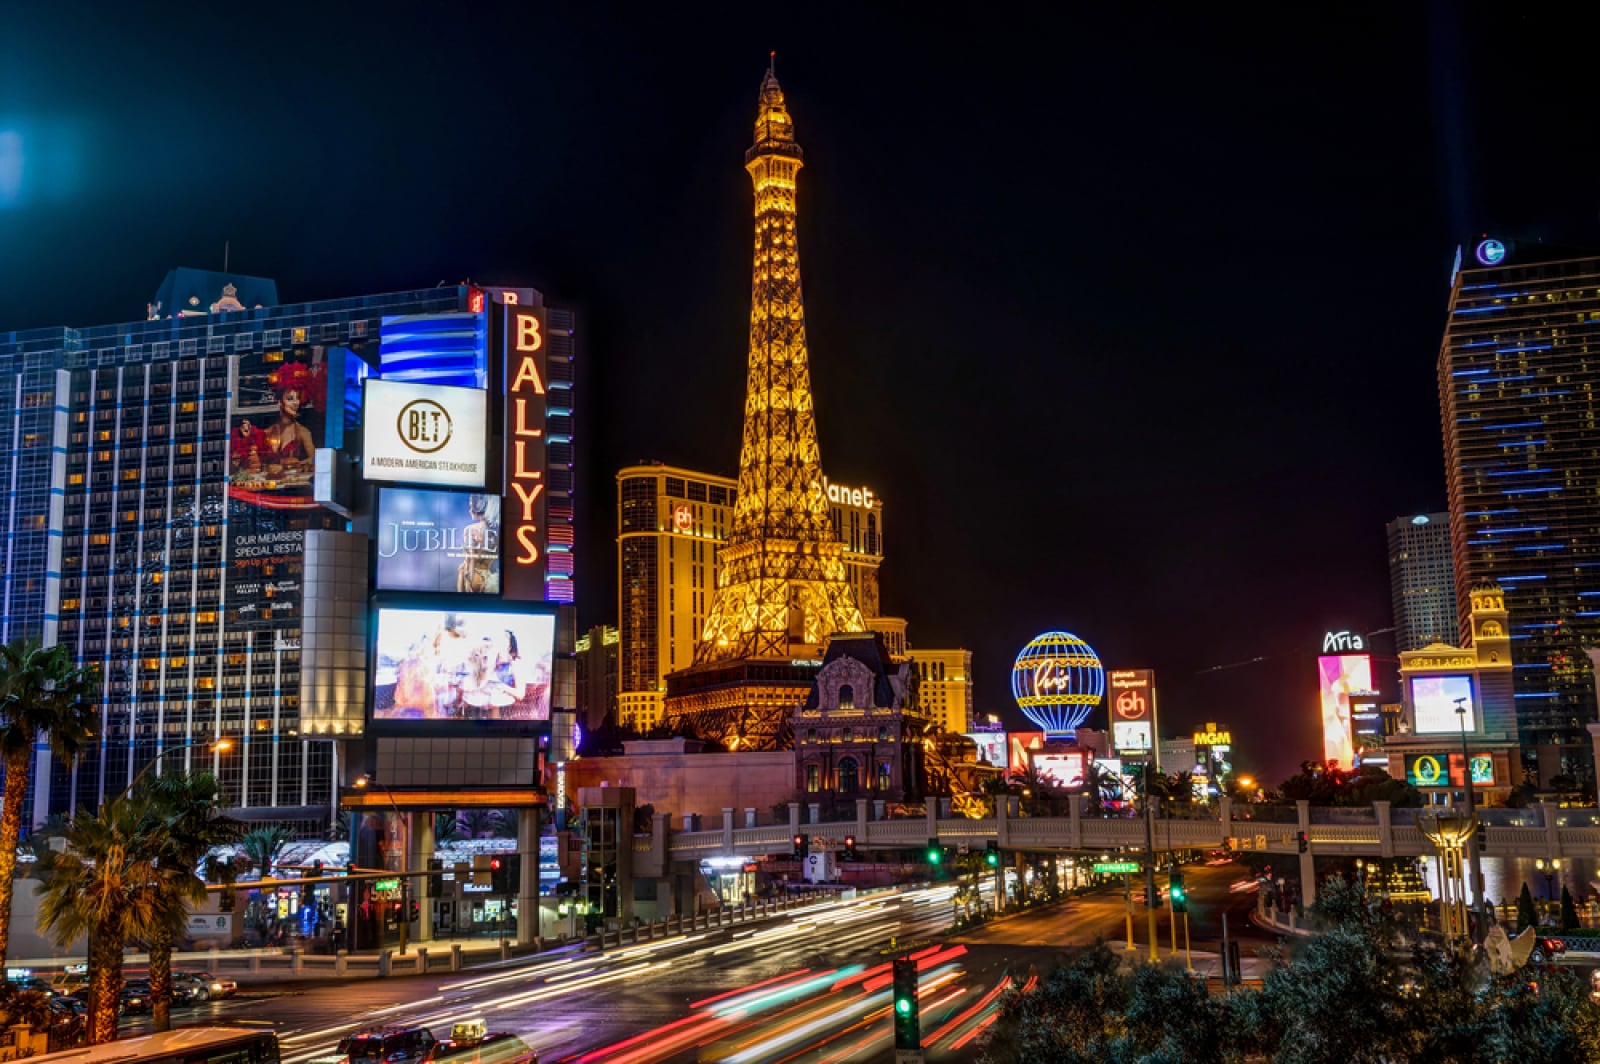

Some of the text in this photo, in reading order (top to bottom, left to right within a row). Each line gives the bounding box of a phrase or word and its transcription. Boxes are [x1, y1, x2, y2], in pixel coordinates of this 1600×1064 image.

[408, 409, 441, 442] BLT
[511, 314, 545, 564] BALLYS
[377, 458, 403, 468] MODERN
[405, 459, 437, 470] AMERICAN
[438, 461, 477, 473] STEAKHOUSE
[235, 545, 272, 557] SPECIAL
[236, 531, 303, 545] OUR MEMBERS
[379, 522, 497, 557] JUBILEE
[1034, 658, 1070, 700] Paris
[1118, 690, 1145, 717] ph
[1194, 731, 1231, 745] MGM
